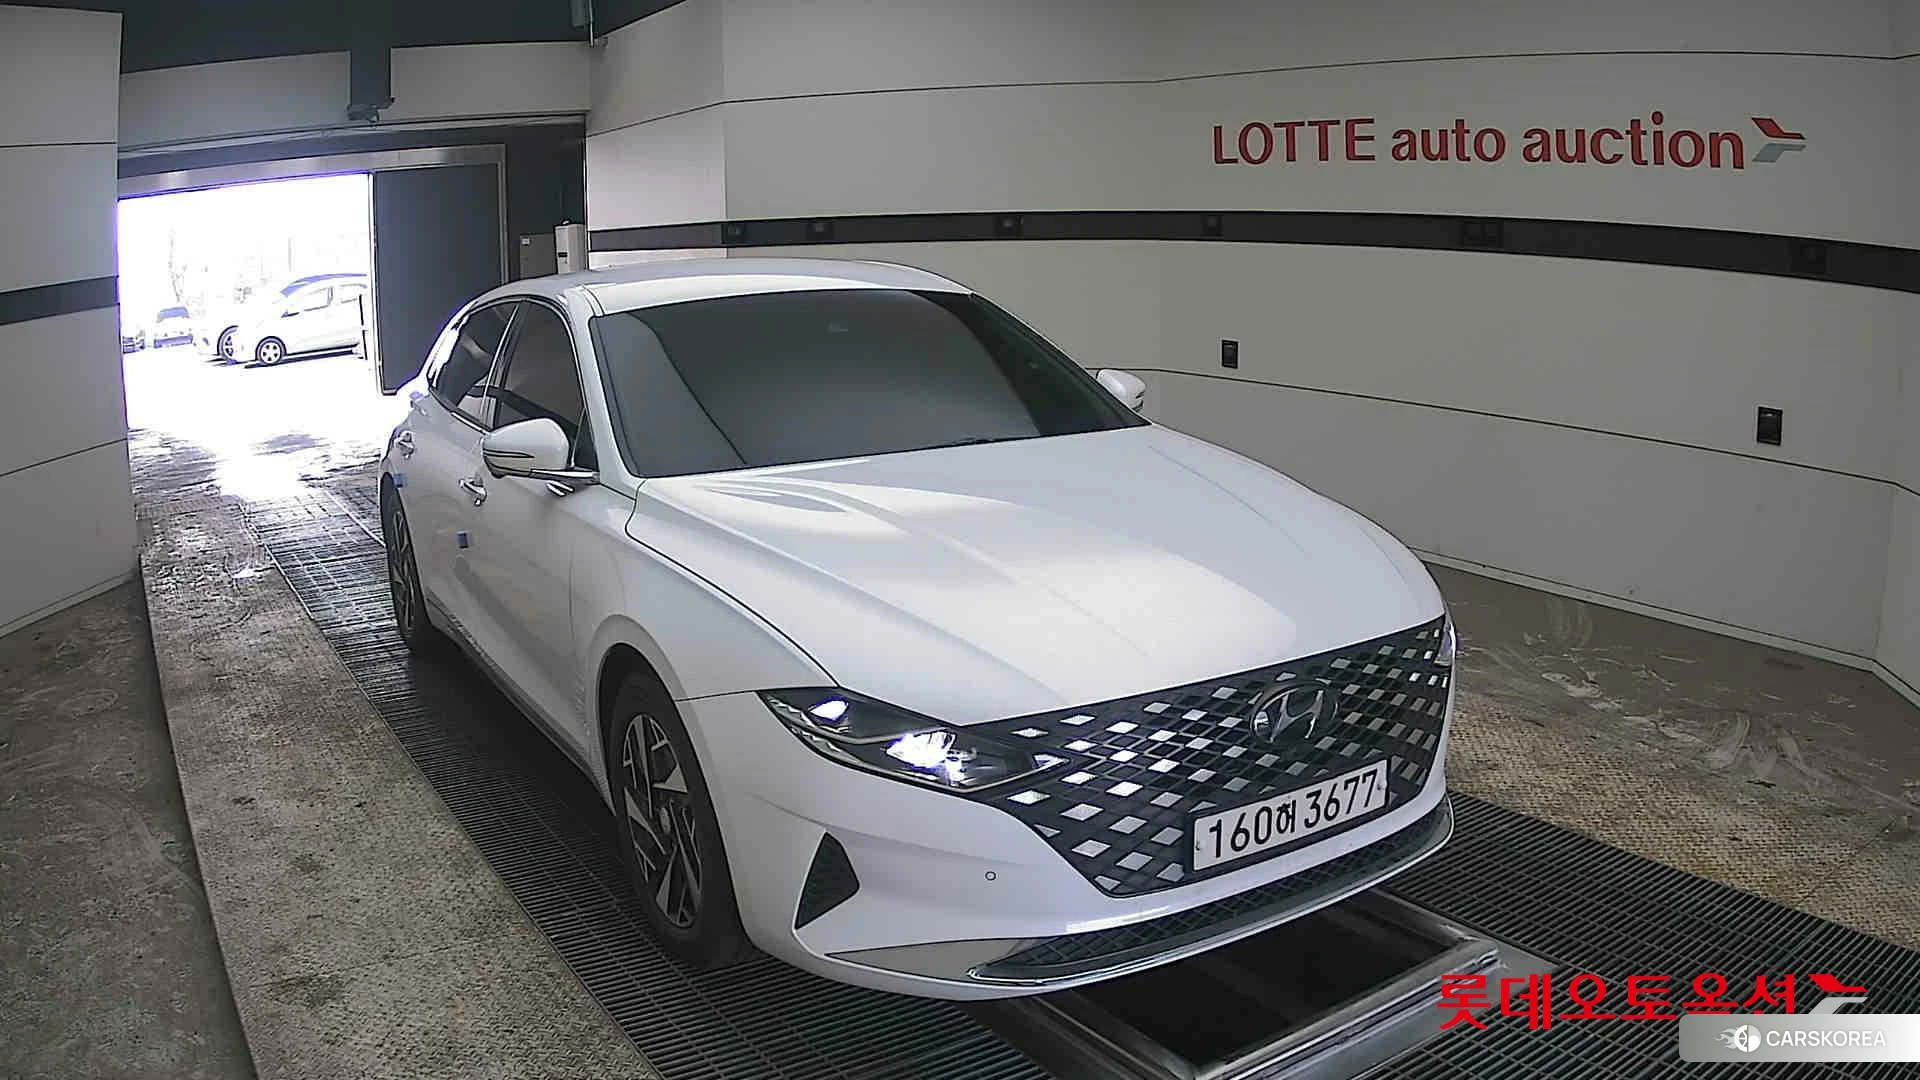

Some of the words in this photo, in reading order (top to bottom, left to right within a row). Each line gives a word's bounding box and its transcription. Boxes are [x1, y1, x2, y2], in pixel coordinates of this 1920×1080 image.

[1212, 118, 1376, 165] LOTTE
[1391, 119, 1506, 162] auto
[1522, 111, 1745, 170] auction
[1208, 799, 1297, 859] 160허
[1303, 768, 1379, 830] 3677
